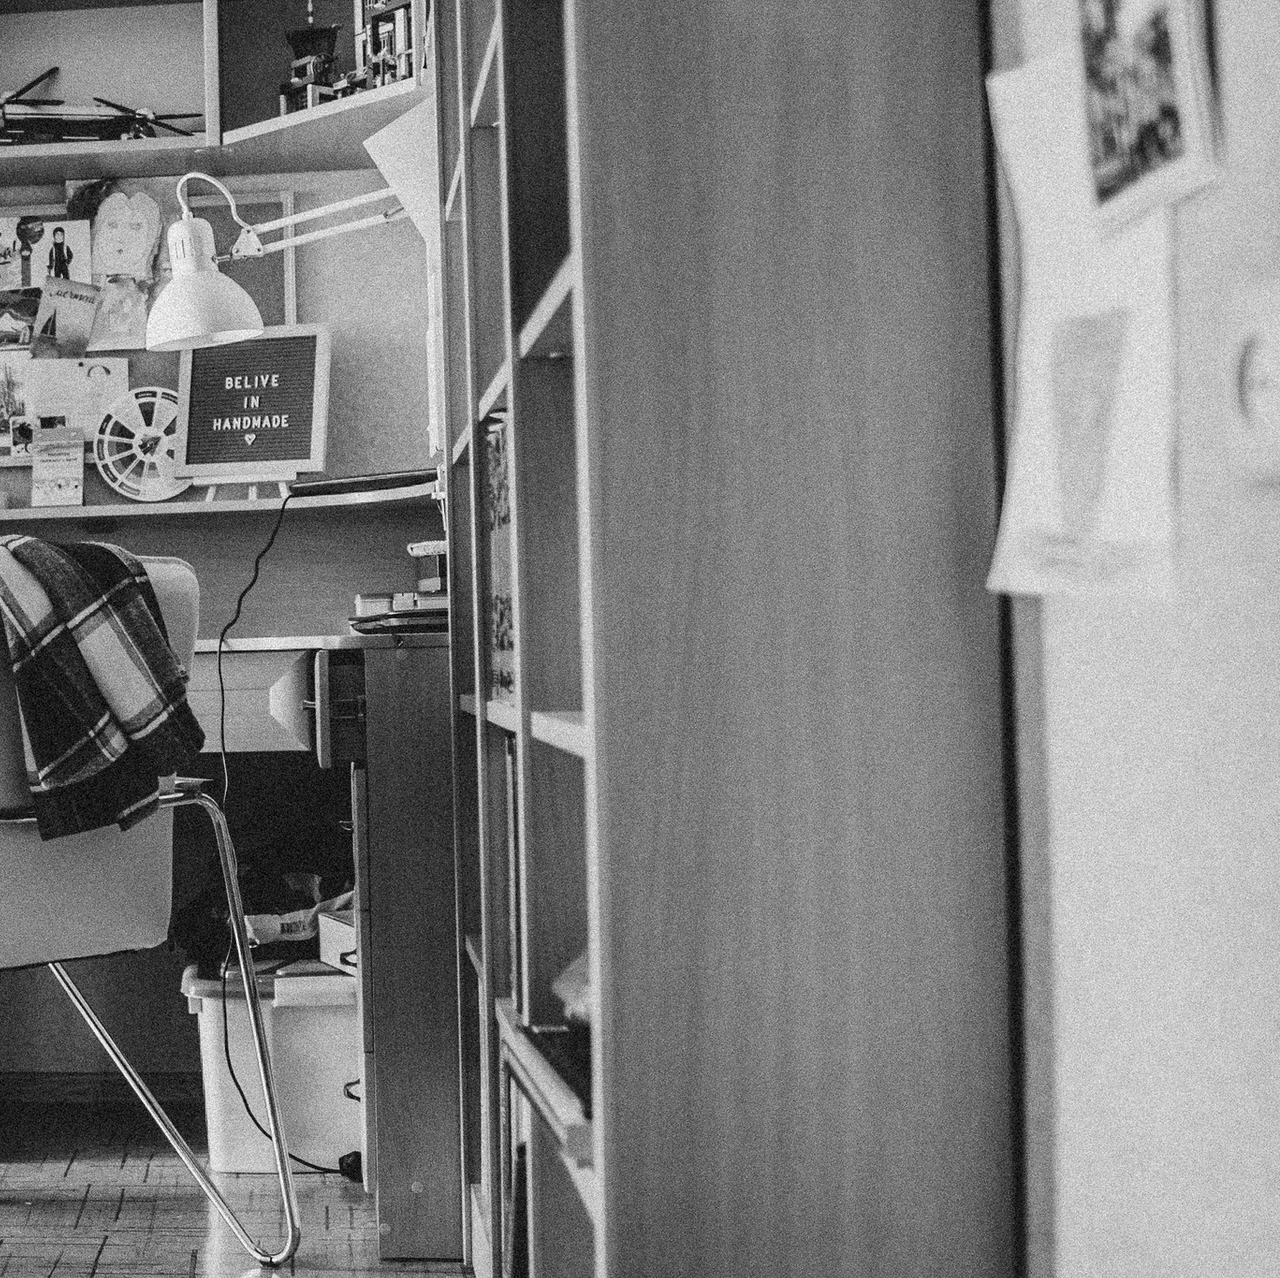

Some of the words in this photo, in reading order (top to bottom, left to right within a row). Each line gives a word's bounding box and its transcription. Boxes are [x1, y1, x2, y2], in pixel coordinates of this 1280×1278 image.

[225, 374, 280, 390] BELIVE
[243, 395, 260, 409] IN
[212, 414, 289, 431] HANDMADE
